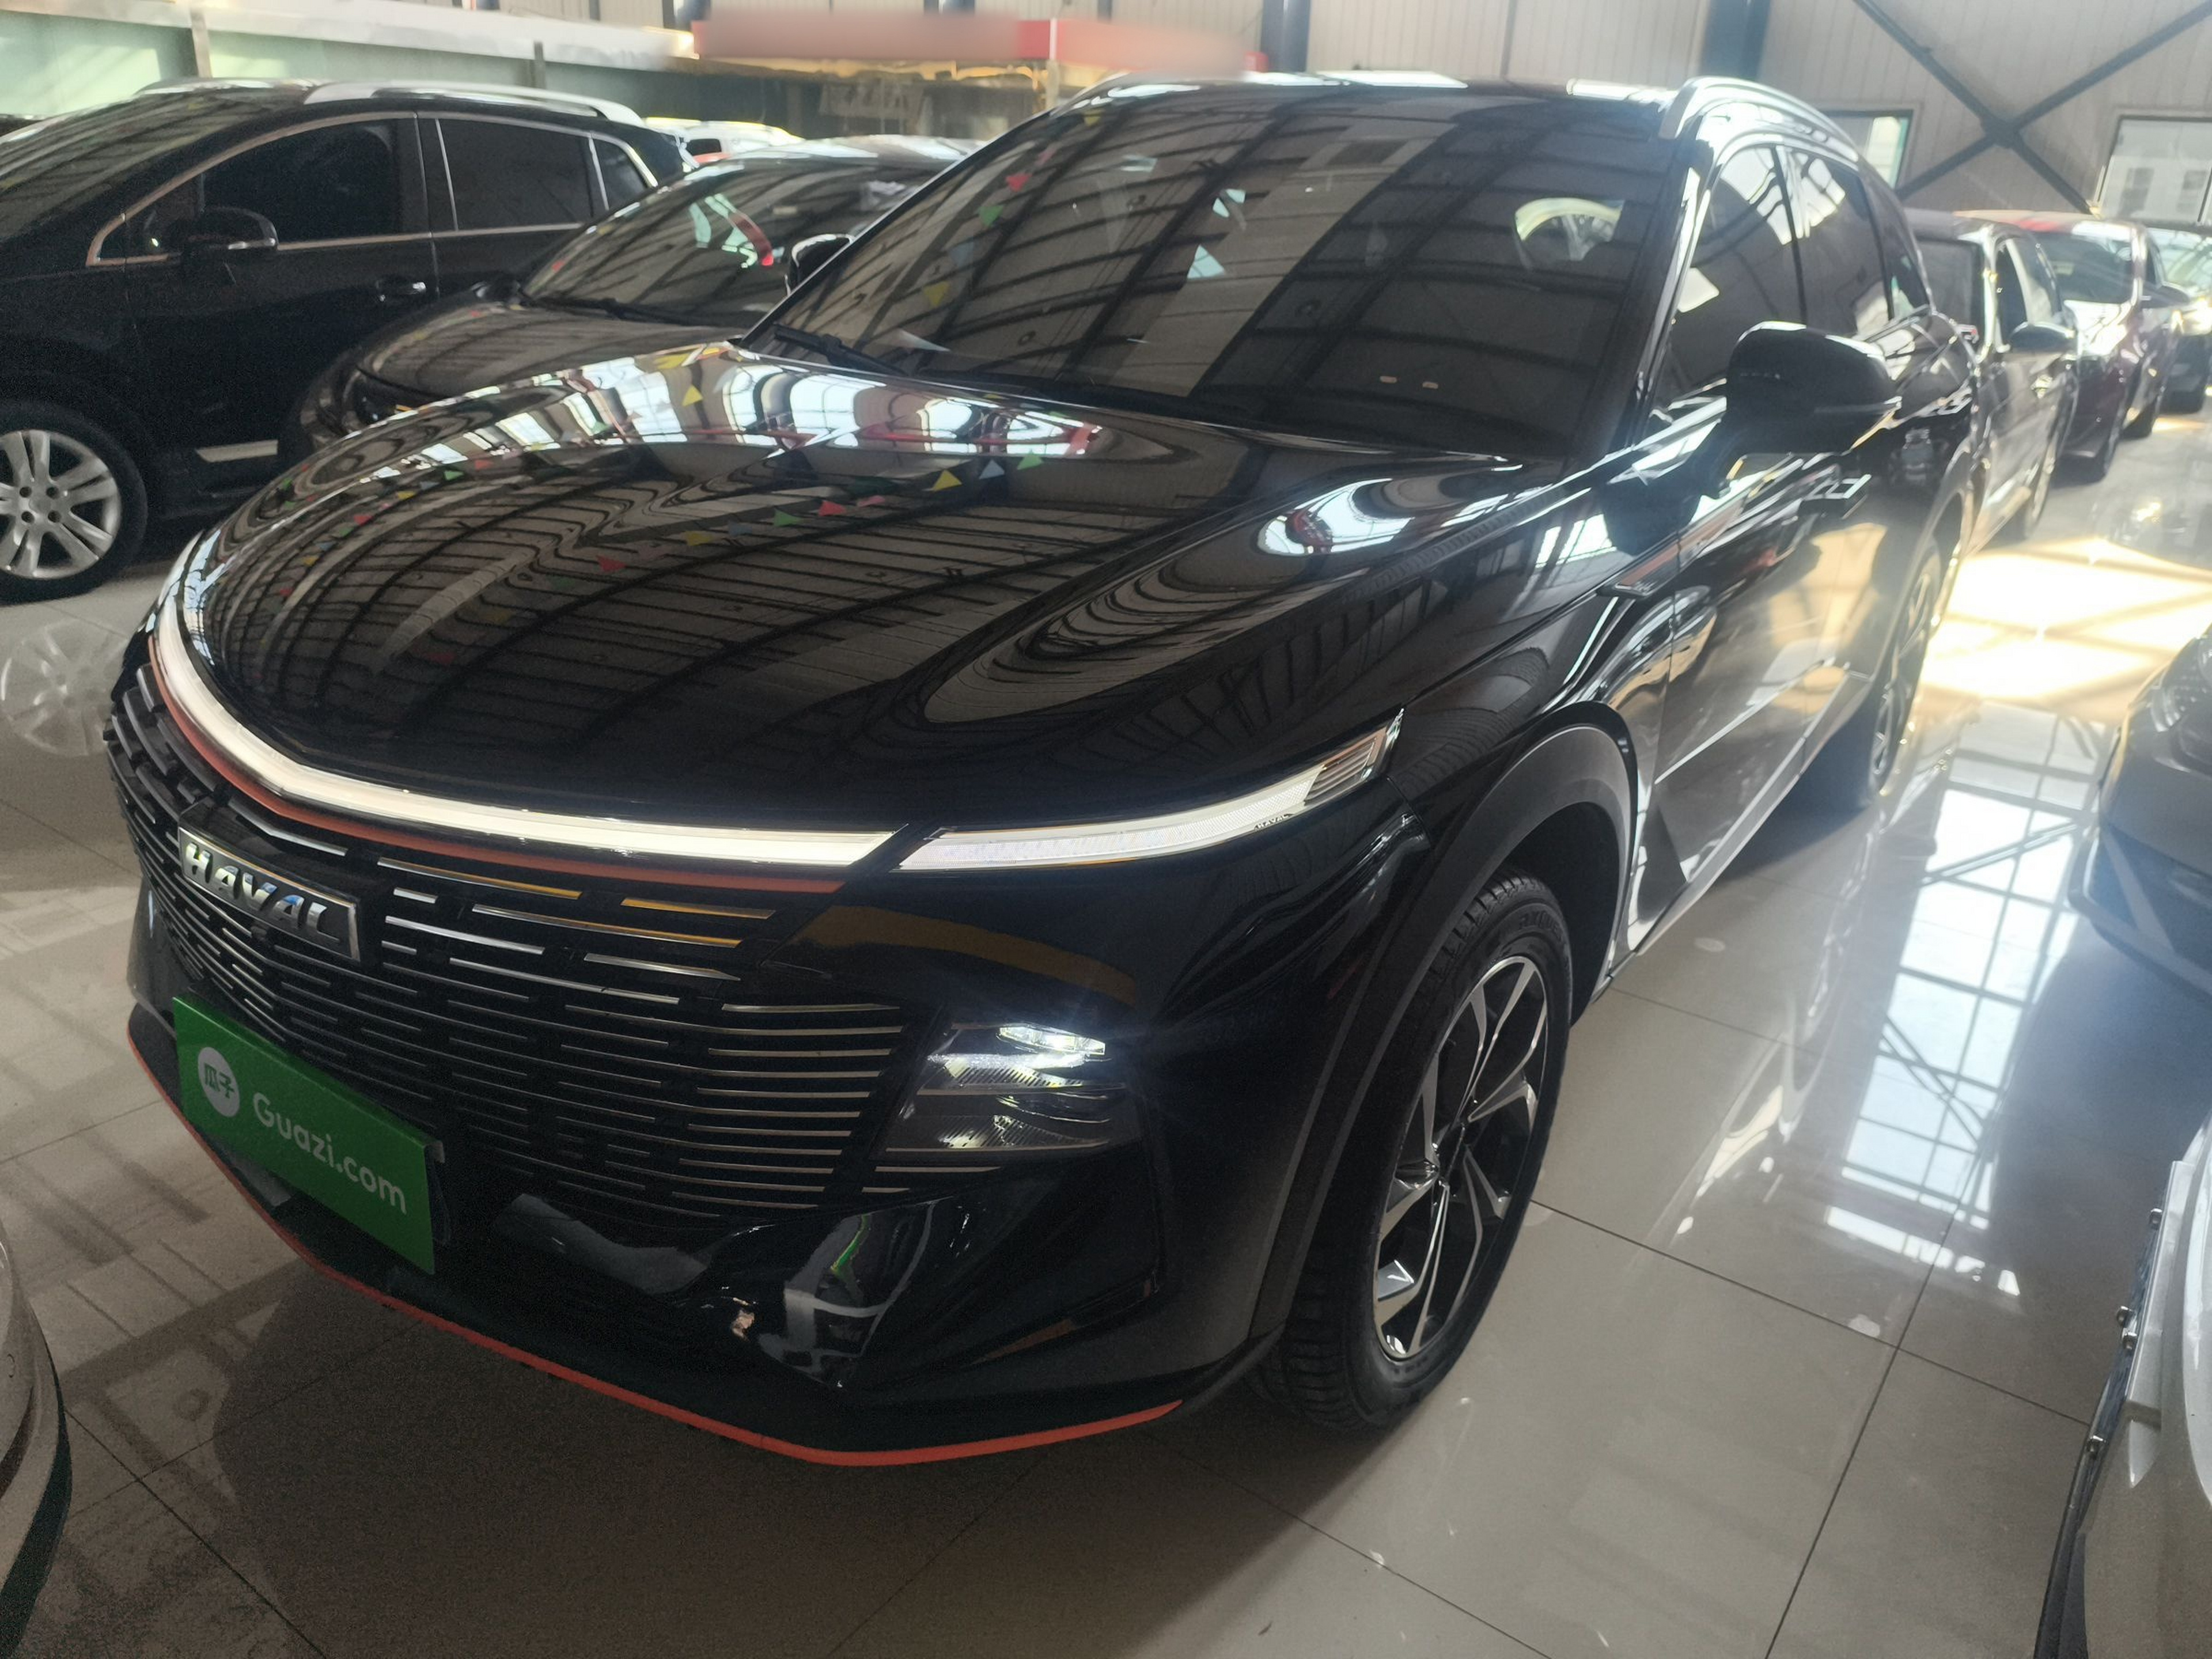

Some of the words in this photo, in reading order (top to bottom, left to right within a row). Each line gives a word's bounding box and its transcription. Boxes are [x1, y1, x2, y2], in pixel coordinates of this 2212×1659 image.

[185, 841, 340, 944] HAVAL
[204, 1062, 234, 1099] 瓜子
[253, 1092, 407, 1215] Guazi.com
